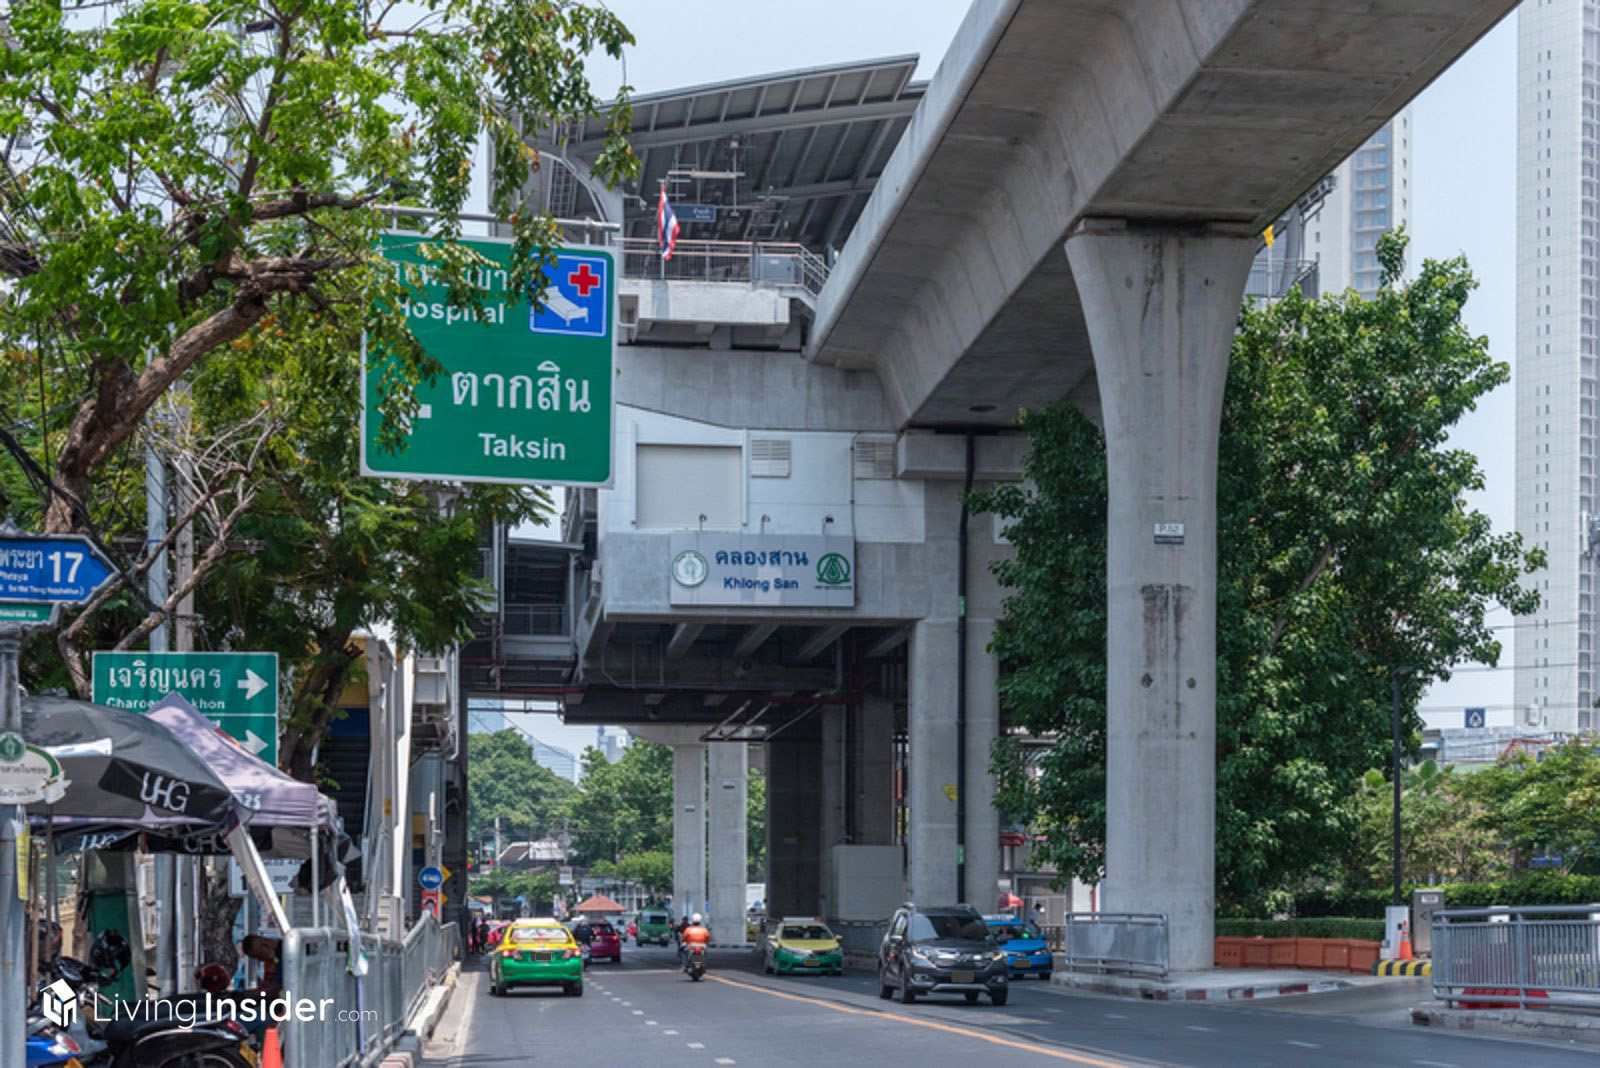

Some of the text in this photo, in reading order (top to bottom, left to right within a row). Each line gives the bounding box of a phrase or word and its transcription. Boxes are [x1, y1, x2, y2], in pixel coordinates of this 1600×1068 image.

[452, 360, 592, 413] ตากสิน
[478, 432, 566, 461] Taksin
[48, 551, 84, 583] 17
[715, 549, 809, 567] คลองสาน
[723, 576, 770, 592] Khlong
[773, 577, 799, 590] San
[109, 659, 222, 693] เจริญนคร
[106, 697, 159, 711] Charoe
[140, 771, 191, 813] UHG
